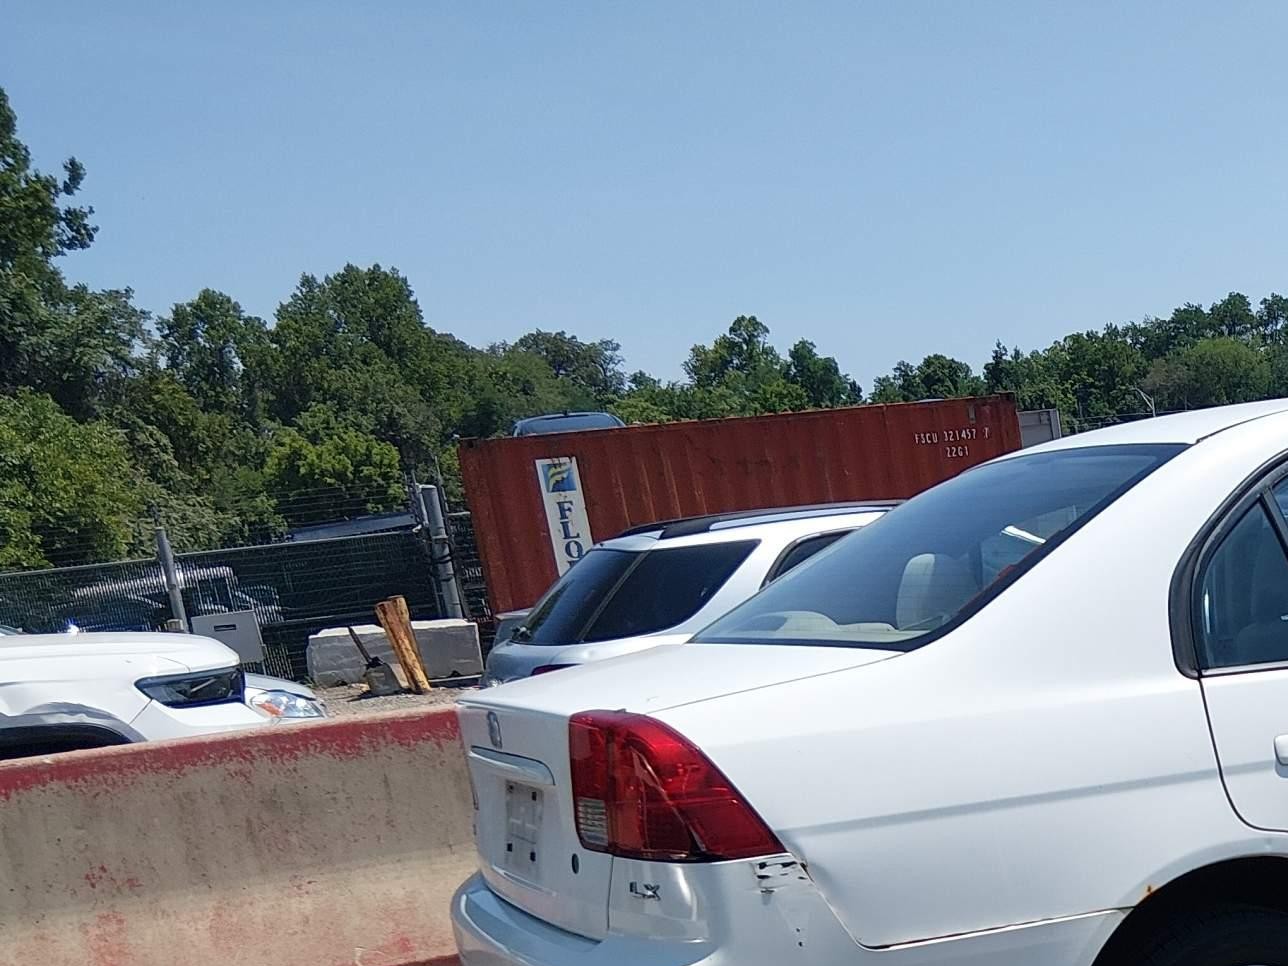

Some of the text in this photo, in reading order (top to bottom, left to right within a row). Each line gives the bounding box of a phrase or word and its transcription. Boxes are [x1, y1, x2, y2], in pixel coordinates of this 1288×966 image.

[915, 432, 938, 444] FSCU
[943, 428, 976, 442] 321457
[629, 881, 661, 901] LX
